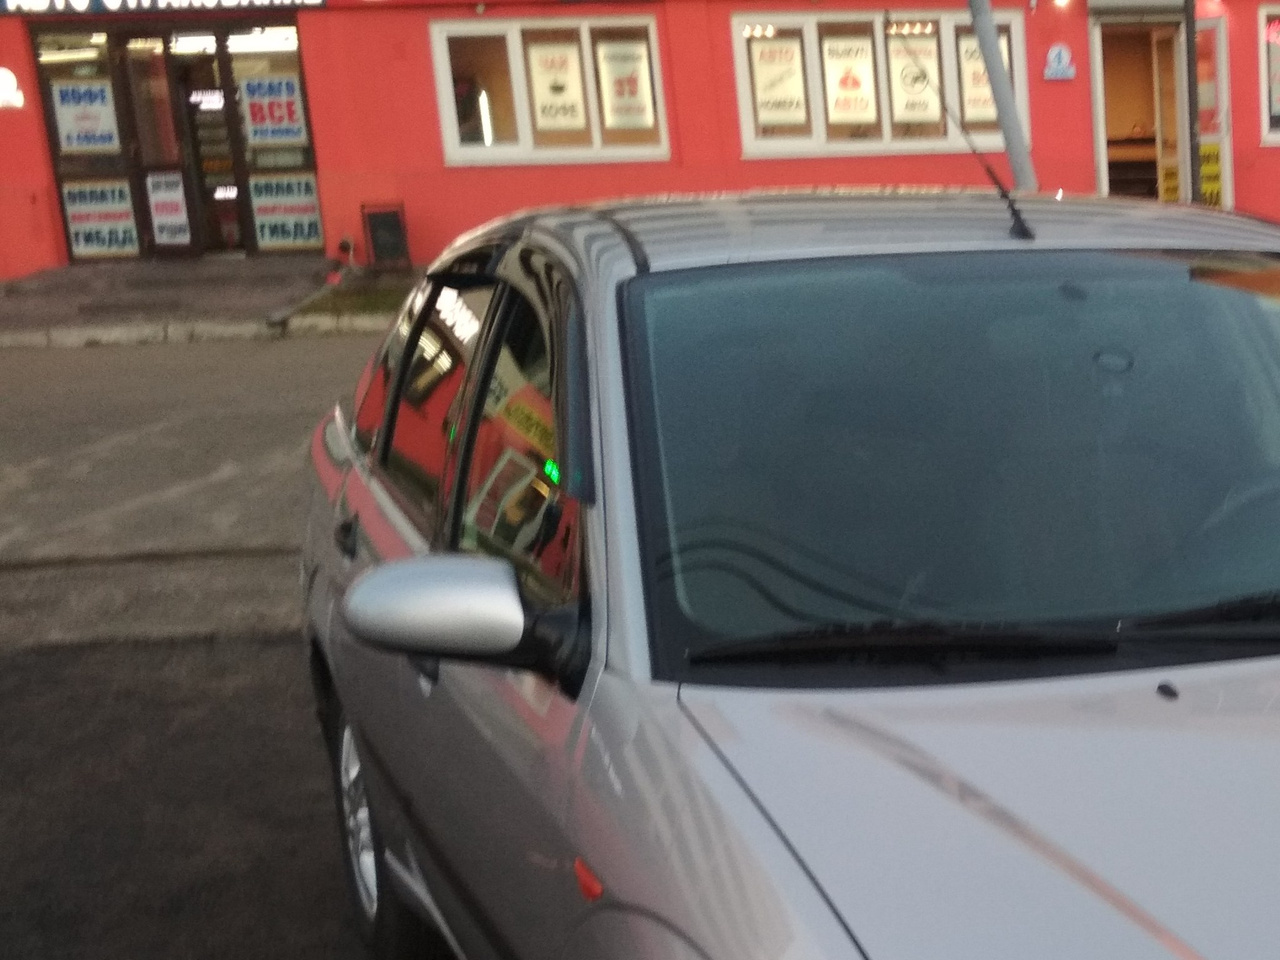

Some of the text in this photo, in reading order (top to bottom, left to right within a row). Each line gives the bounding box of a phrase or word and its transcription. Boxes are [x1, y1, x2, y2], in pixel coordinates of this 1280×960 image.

[249, 101, 299, 125] ВСЕ
[73, 229, 135, 249] ГИБДД
[259, 220, 320, 241] ГИБДД
